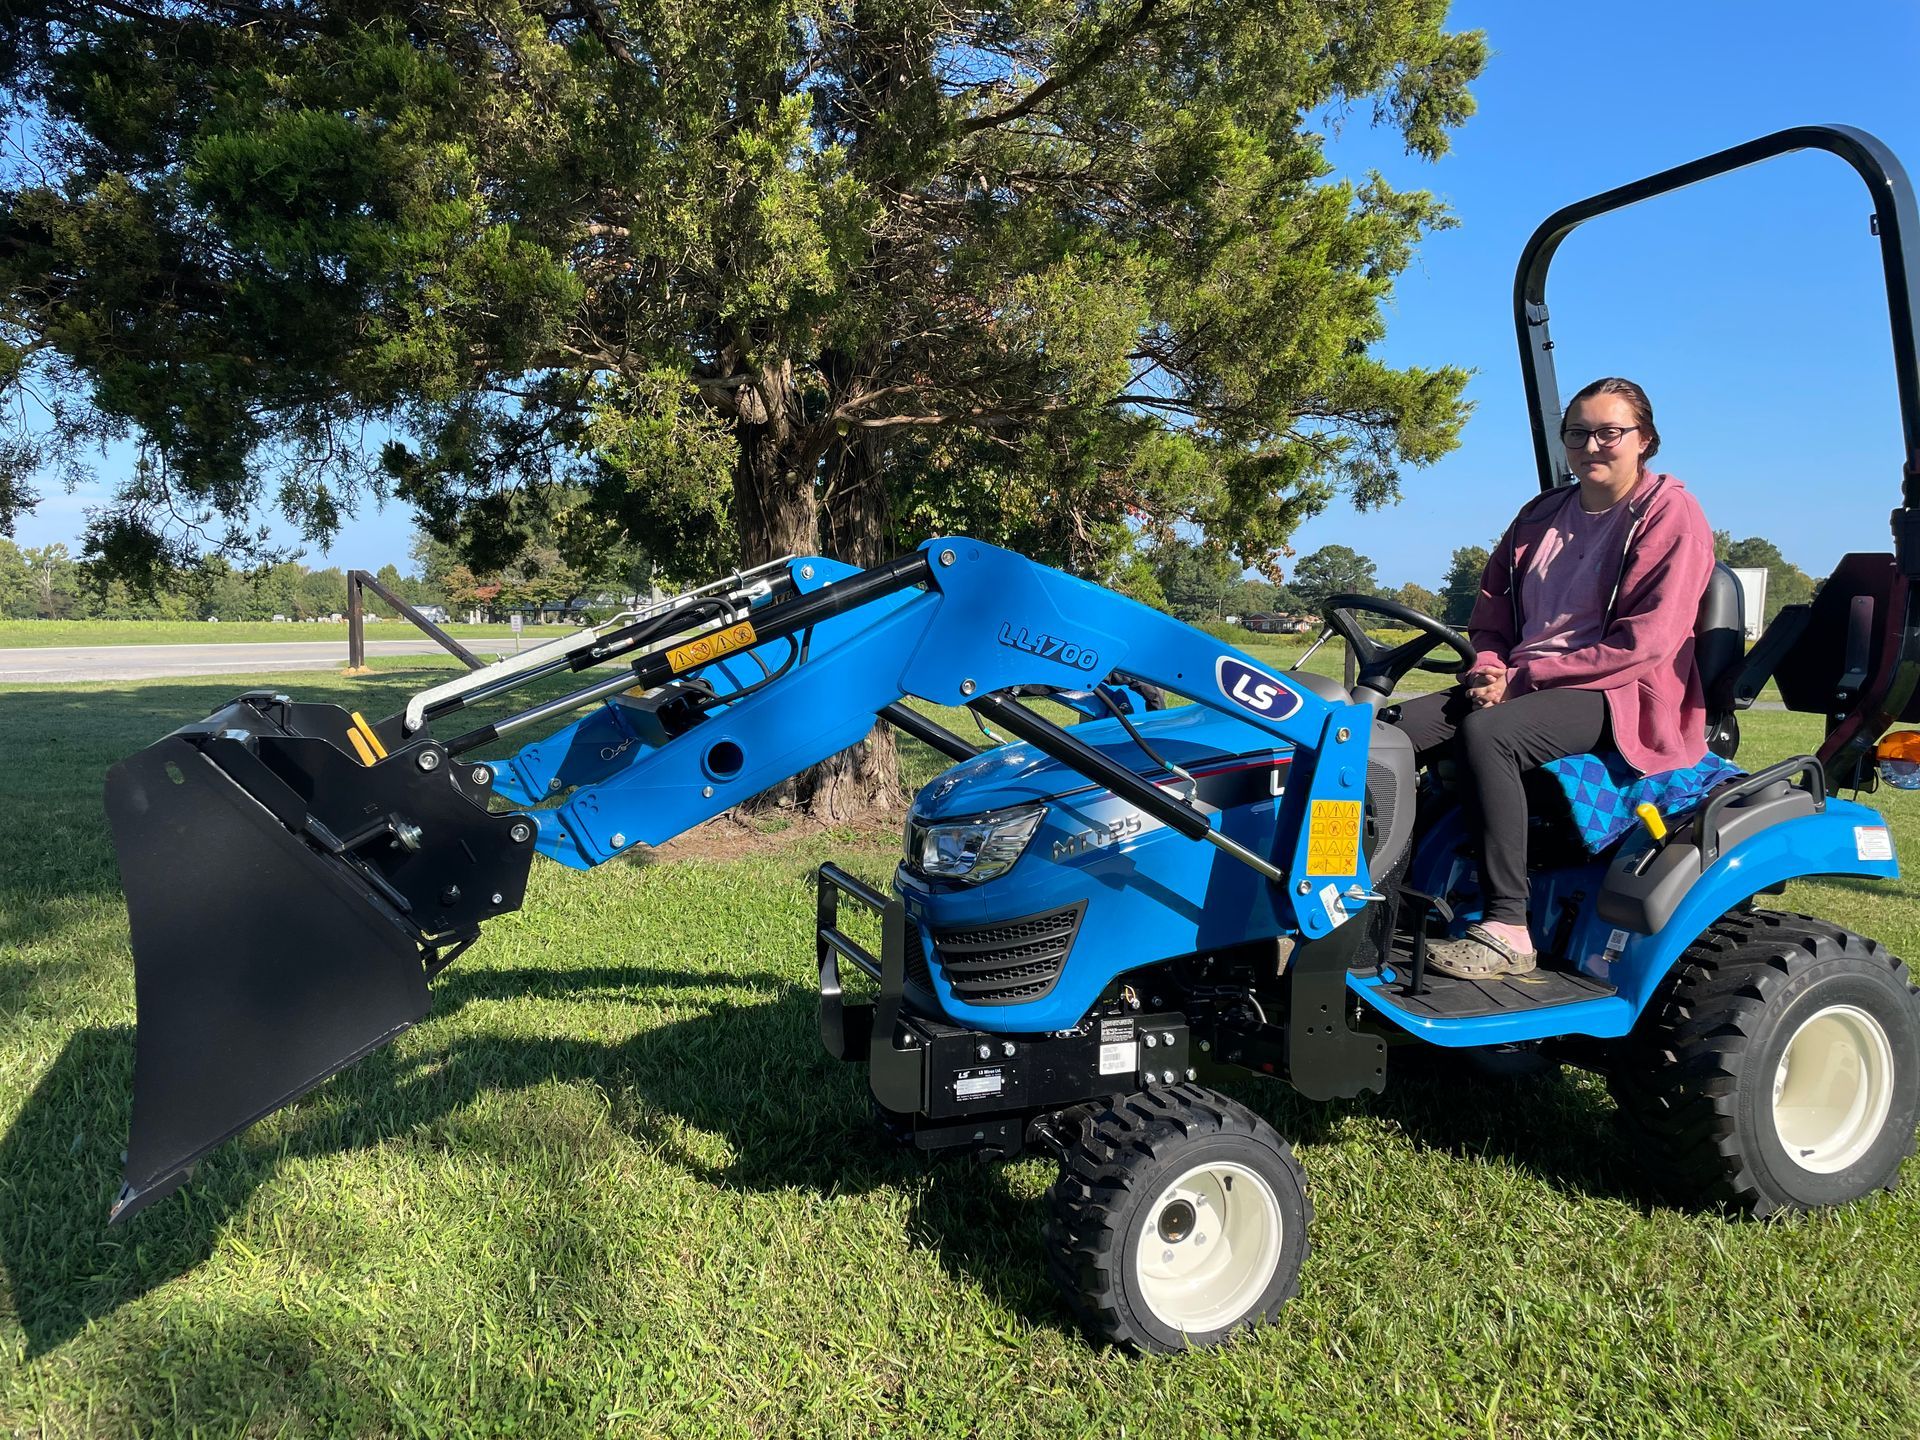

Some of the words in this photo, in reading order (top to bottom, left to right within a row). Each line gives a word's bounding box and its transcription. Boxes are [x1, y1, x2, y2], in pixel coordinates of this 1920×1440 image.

[998, 621, 1099, 672] LL1700
[1232, 673, 1280, 710] LS
[1052, 813, 1142, 860] MT125
